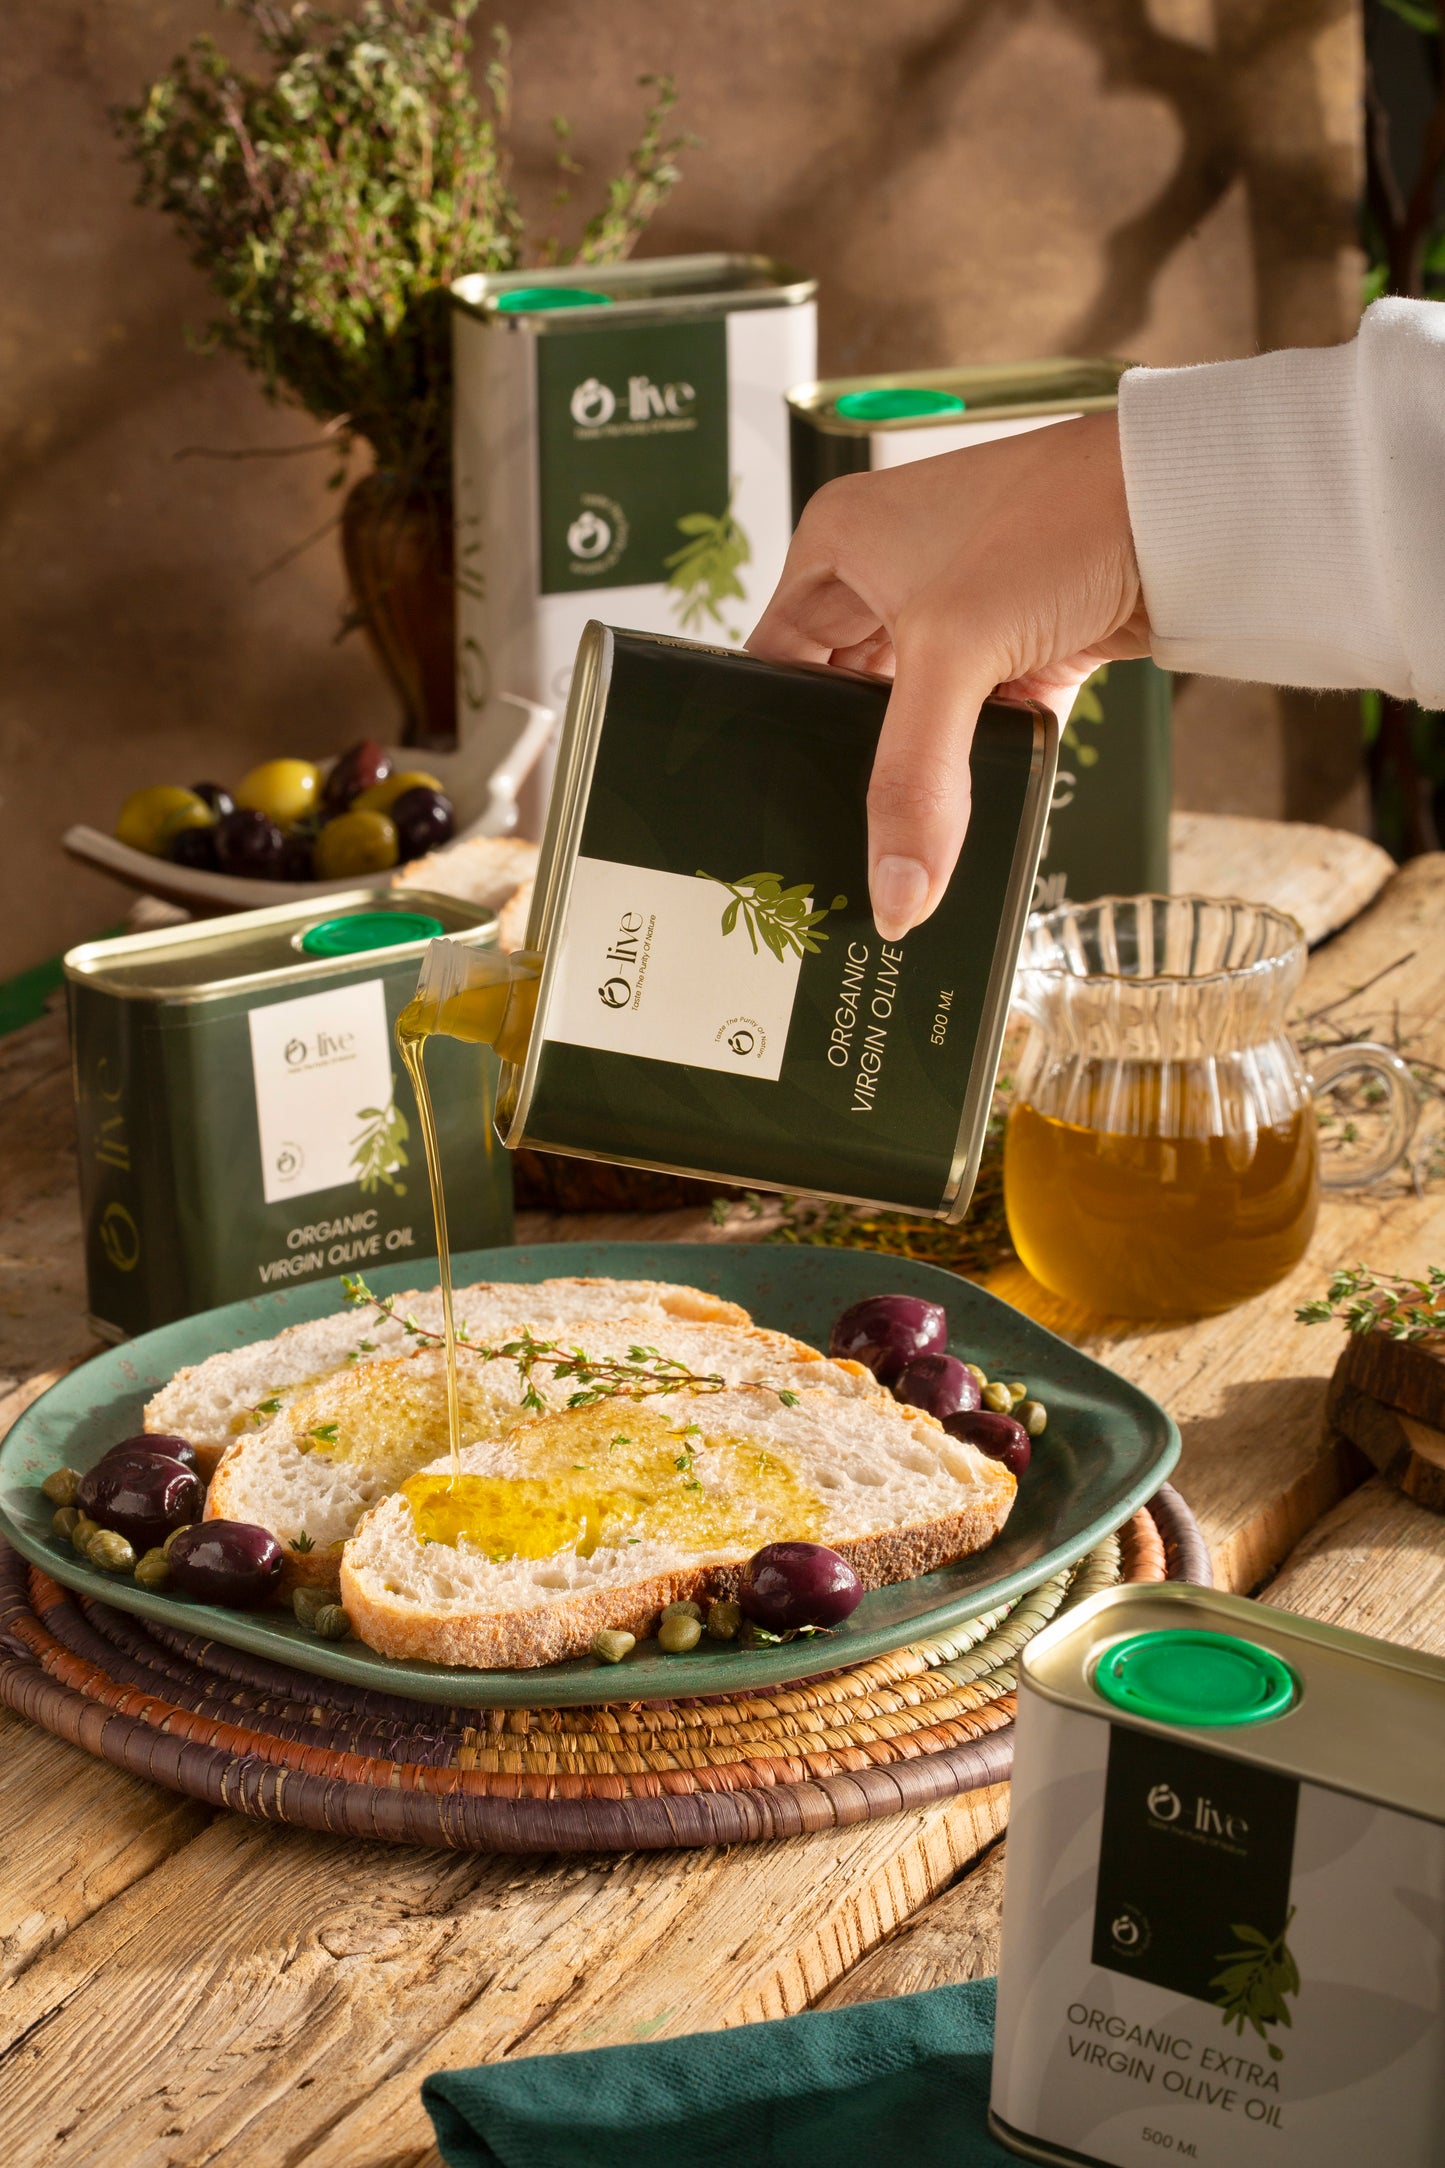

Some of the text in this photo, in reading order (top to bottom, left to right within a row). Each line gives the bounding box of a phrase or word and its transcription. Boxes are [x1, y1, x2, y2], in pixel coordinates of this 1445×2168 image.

[631, 914, 657, 1011] Taste The Purity Of Nature
[740, 1016, 759, 1028] Purity
[827, 942, 869, 1067] ORGANIC
[851, 944, 903, 1111] VIRGIN OLIVE
[930, 989, 954, 1046] 500 ML
[258, 1226, 416, 1284] VIRGIN OLIVE OIL
[286, 1208, 379, 1250] ORGANIC
[1066, 2002, 1280, 2093] ORGANIC EXTRA
[1067, 2034, 1284, 2130] VIRGIN OLIVE OIL
[1141, 2127, 1199, 2159] 500 ML
